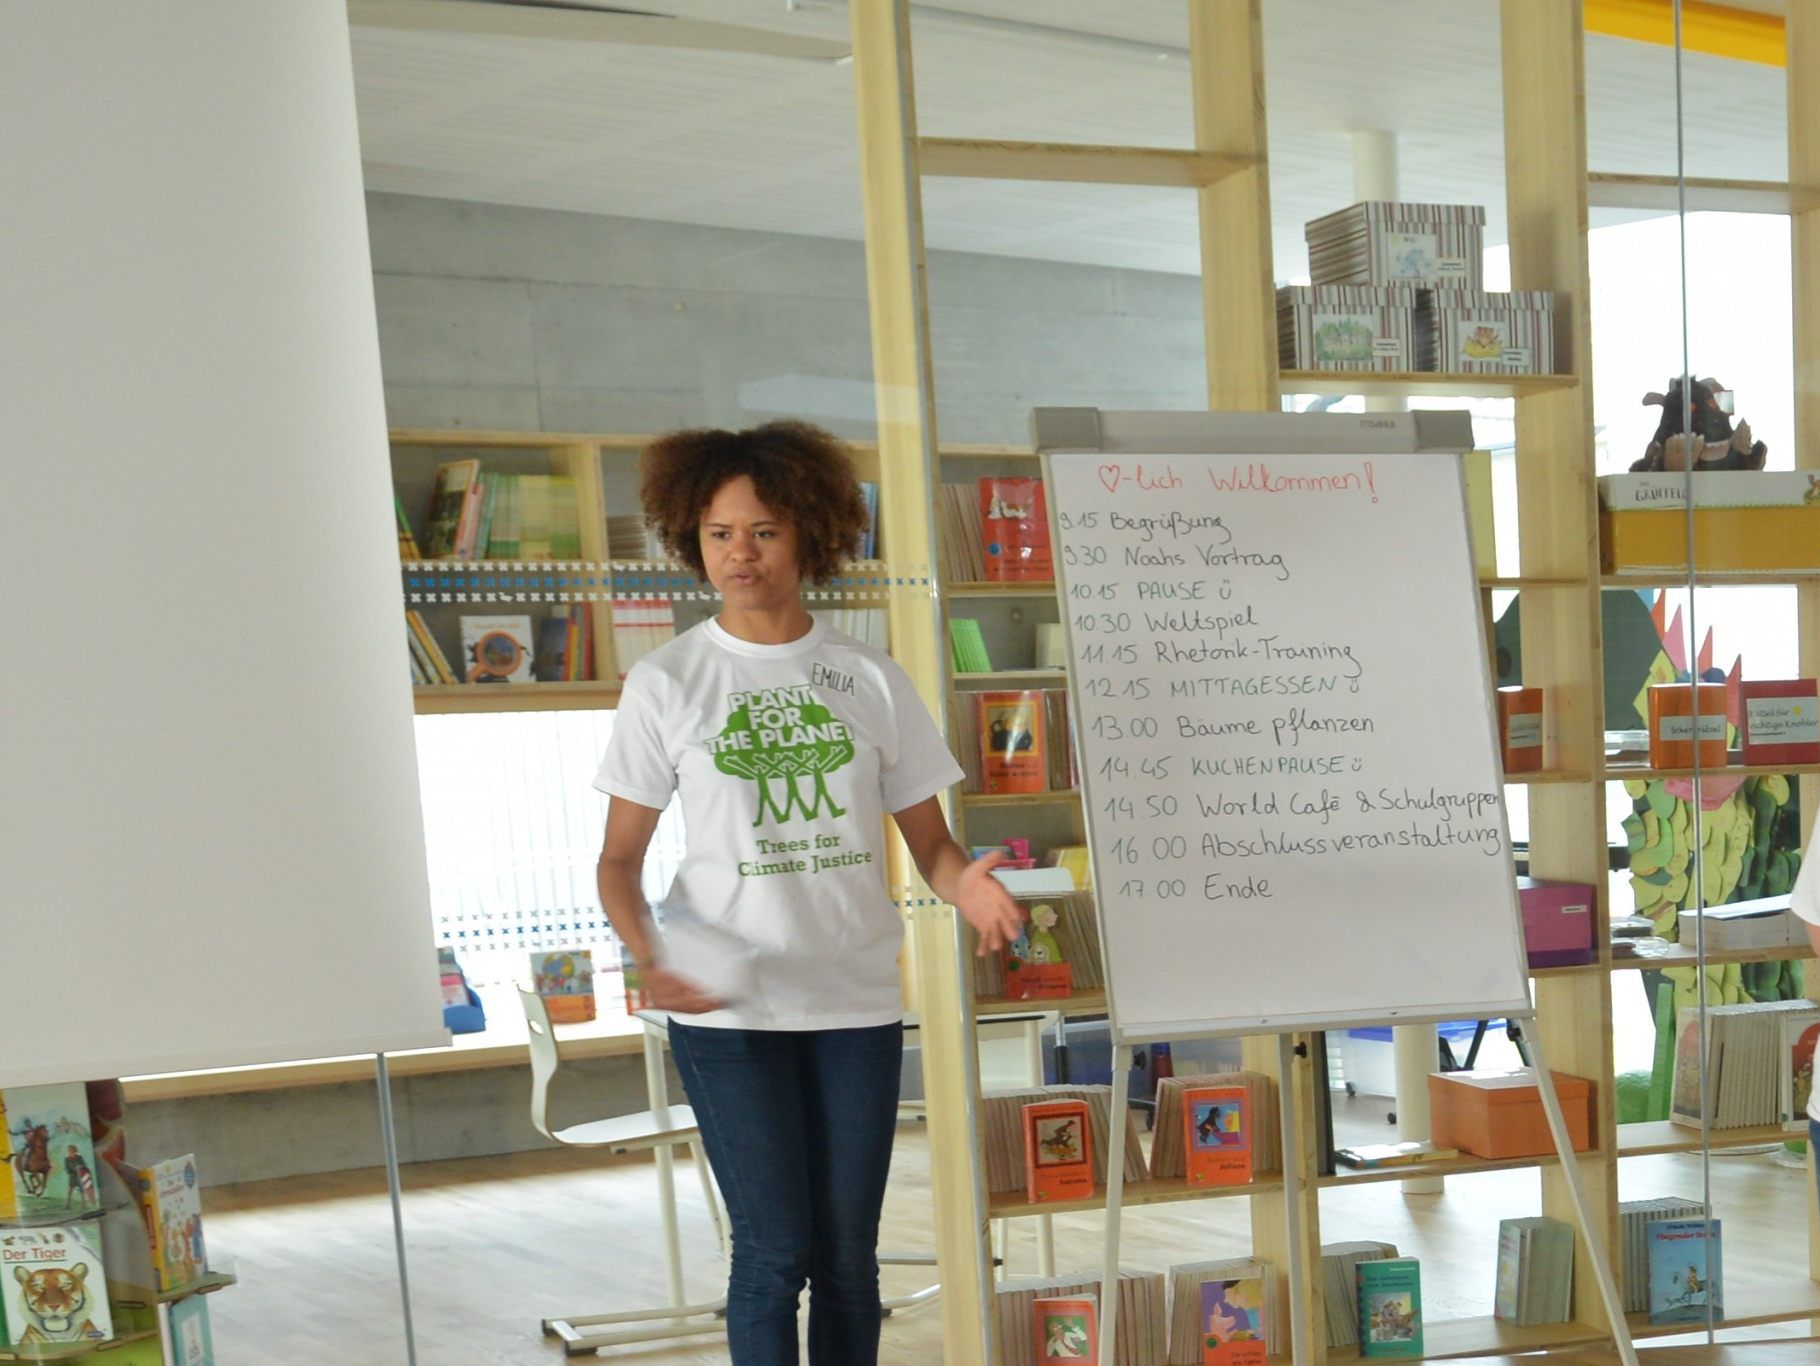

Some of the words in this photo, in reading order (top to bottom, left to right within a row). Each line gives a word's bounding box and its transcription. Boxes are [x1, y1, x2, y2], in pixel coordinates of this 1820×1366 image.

[1110, 511, 1232, 545] Begrüßung
[1125, 546, 1186, 567] Noahs
[1195, 544, 1290, 581] Vortrag
[1071, 583, 1119, 600] 10.15
[1137, 580, 1206, 600] PAUSE
[1144, 605, 1259, 640] Weltspiel
[1080, 643, 1138, 664] 11.15
[1155, 635, 1362, 679] Rhetorik-Training
[812, 662, 855, 696] EMILIA
[1170, 675, 1338, 699] MITTAGESSEN
[727, 684, 816, 713] PLANT
[751, 708, 804, 730] FOR
[1177, 715, 1262, 738] Bäume
[1272, 707, 1375, 747] pflanzen
[703, 730, 754, 755] THE
[1100, 755, 1172, 782] 14.45
[1191, 756, 1344, 777] KUCHENPAUSE
[1104, 795, 1178, 821] 14.50
[1196, 792, 1279, 818] World
[1289, 788, 1341, 825] Café
[1356, 790, 1377, 813] &
[1379, 787, 1499, 821] Schulgruppen
[756, 837, 809, 855] Trees
[815, 834, 841, 850] for
[811, 850, 872, 874] Justice
[1204, 873, 1273, 899] Ende
[3, 1249, 26, 1261] Der
[32, 1247, 66, 1261] Tiger
